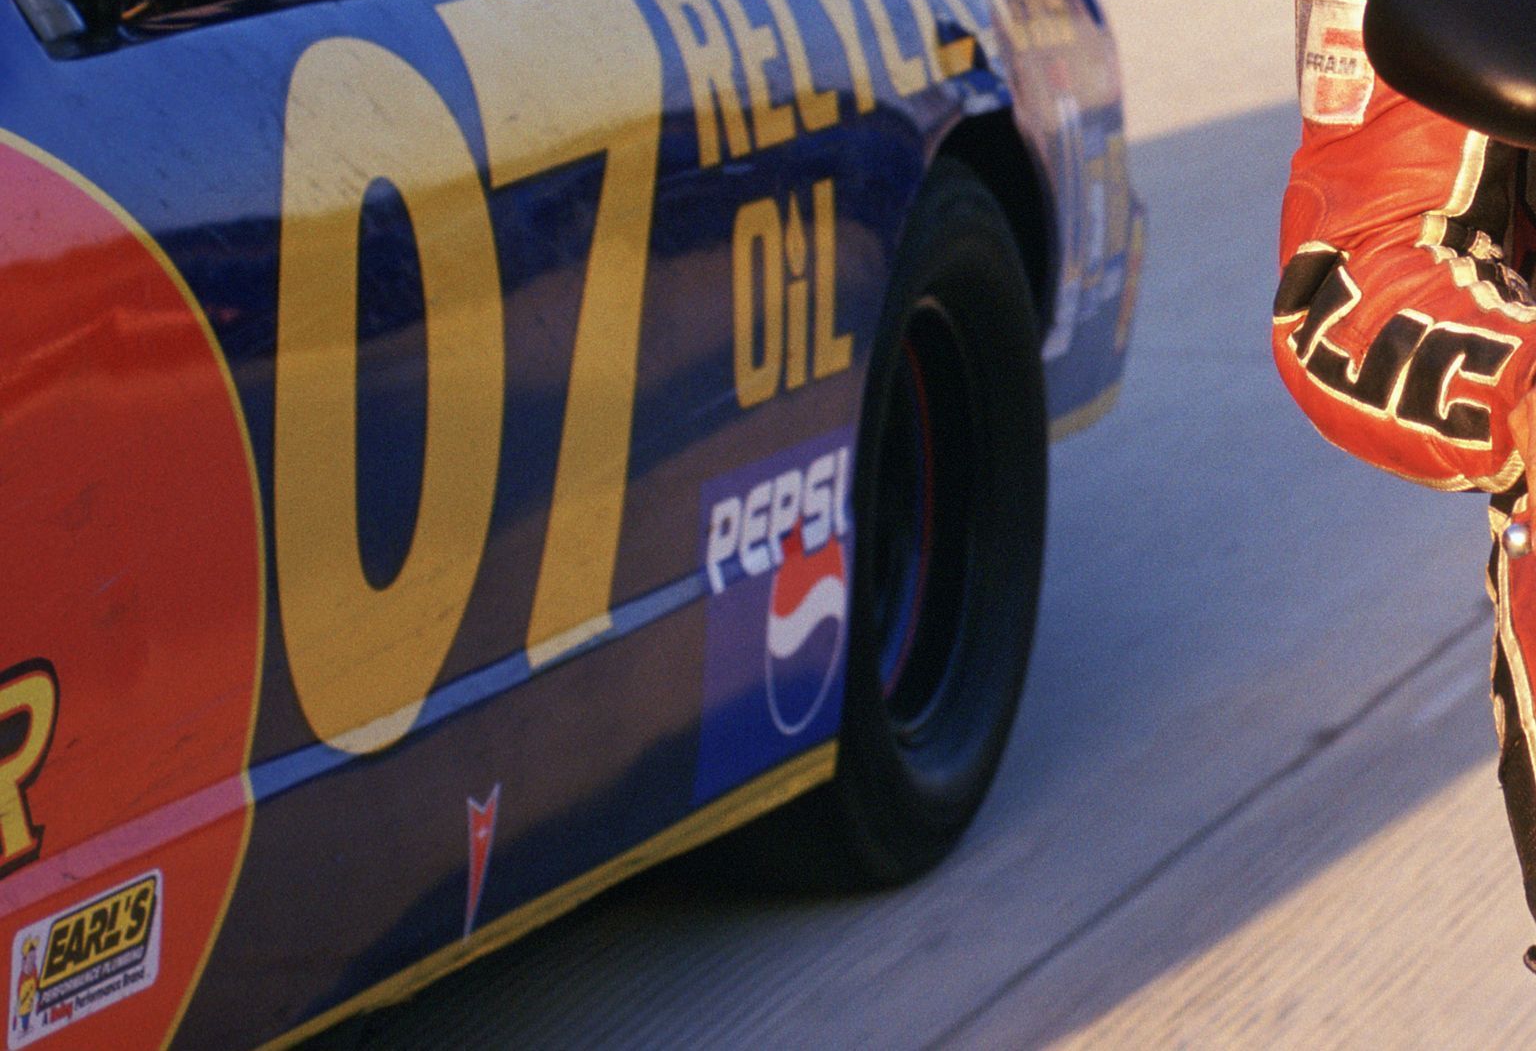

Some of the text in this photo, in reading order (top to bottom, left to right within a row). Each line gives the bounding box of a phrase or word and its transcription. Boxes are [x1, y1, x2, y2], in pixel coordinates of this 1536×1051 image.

[1305, 52, 1358, 76] FRAM
[705, 446, 850, 596] PEPSI
[44, 887, 150, 980] EARL'S
